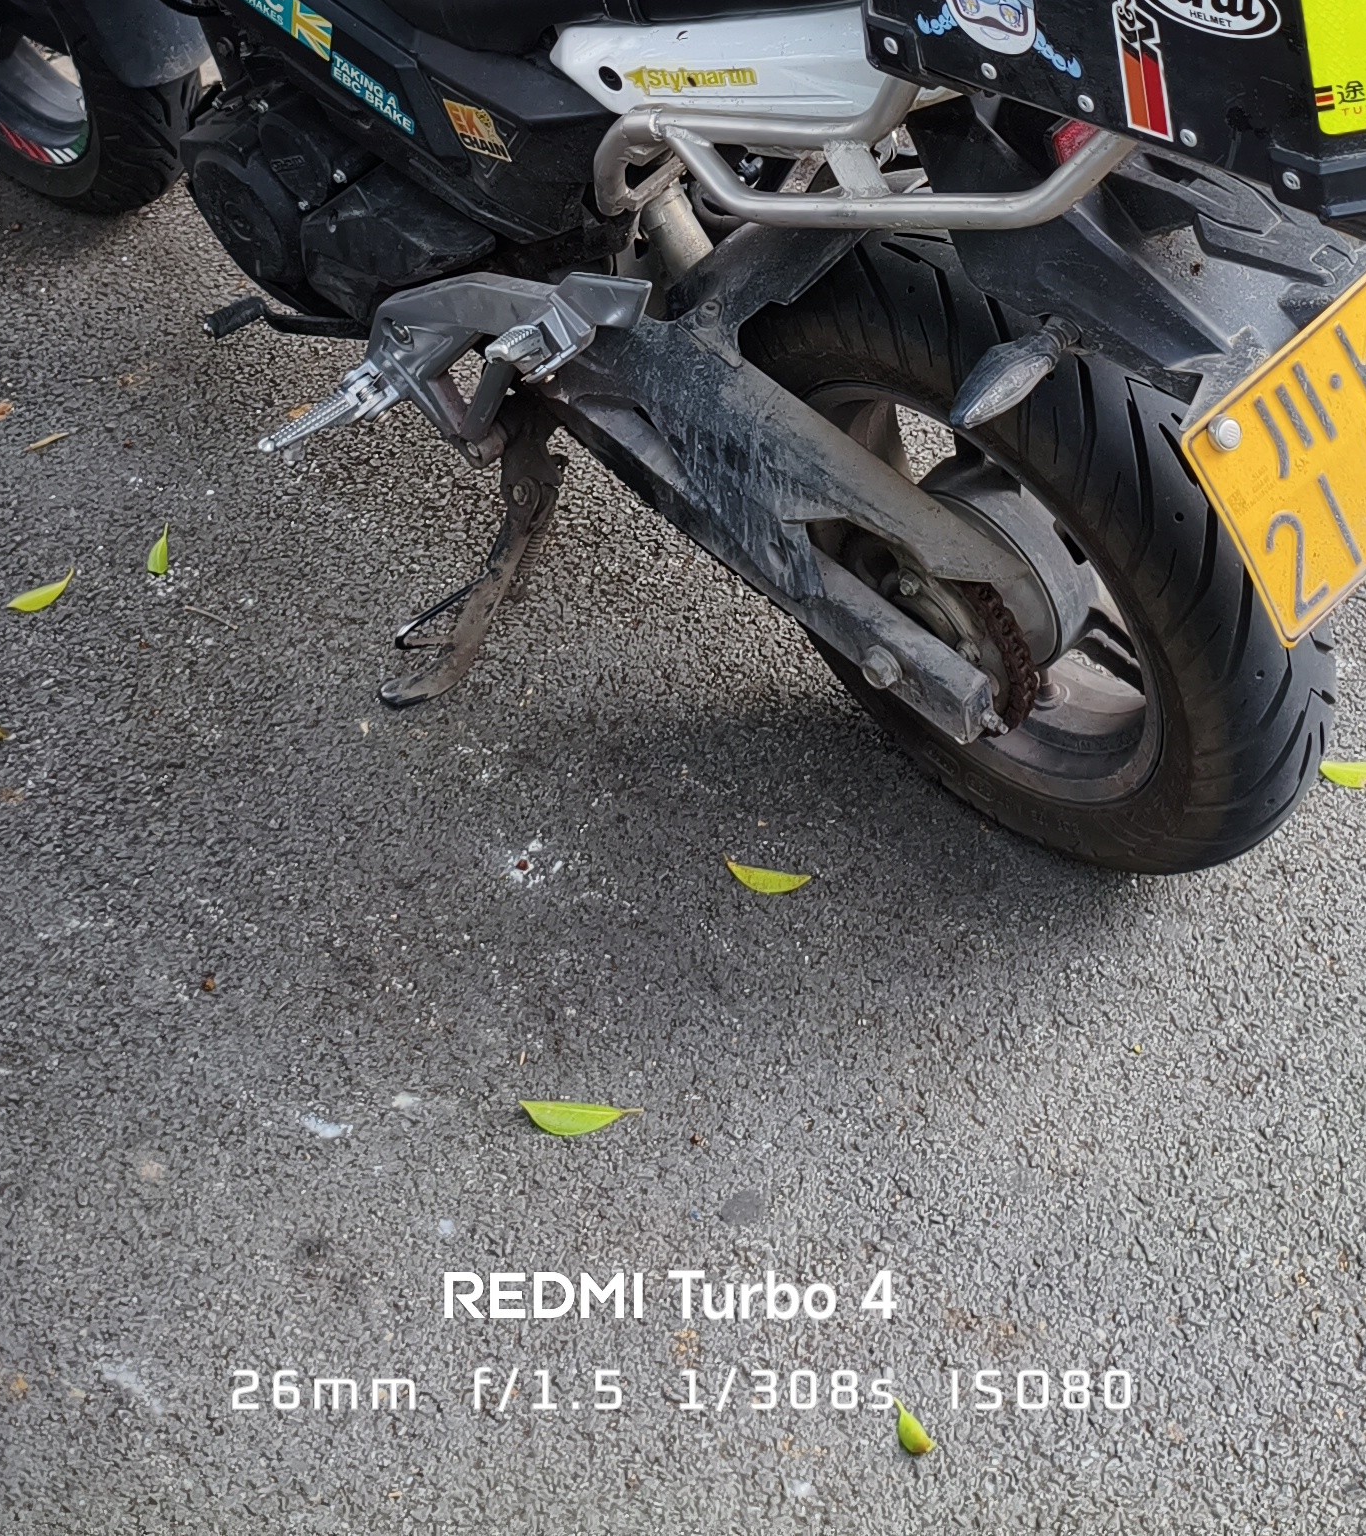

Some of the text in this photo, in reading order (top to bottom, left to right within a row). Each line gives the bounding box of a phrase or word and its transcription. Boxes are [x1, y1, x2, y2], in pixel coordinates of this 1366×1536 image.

[1189, 9, 1233, 28] HELMET
[334, 56, 397, 109] TAKING A
[333, 68, 412, 132] EBC BRAKE
[448, 105, 482, 137] EK
[460, 131, 510, 161] CHAIN
